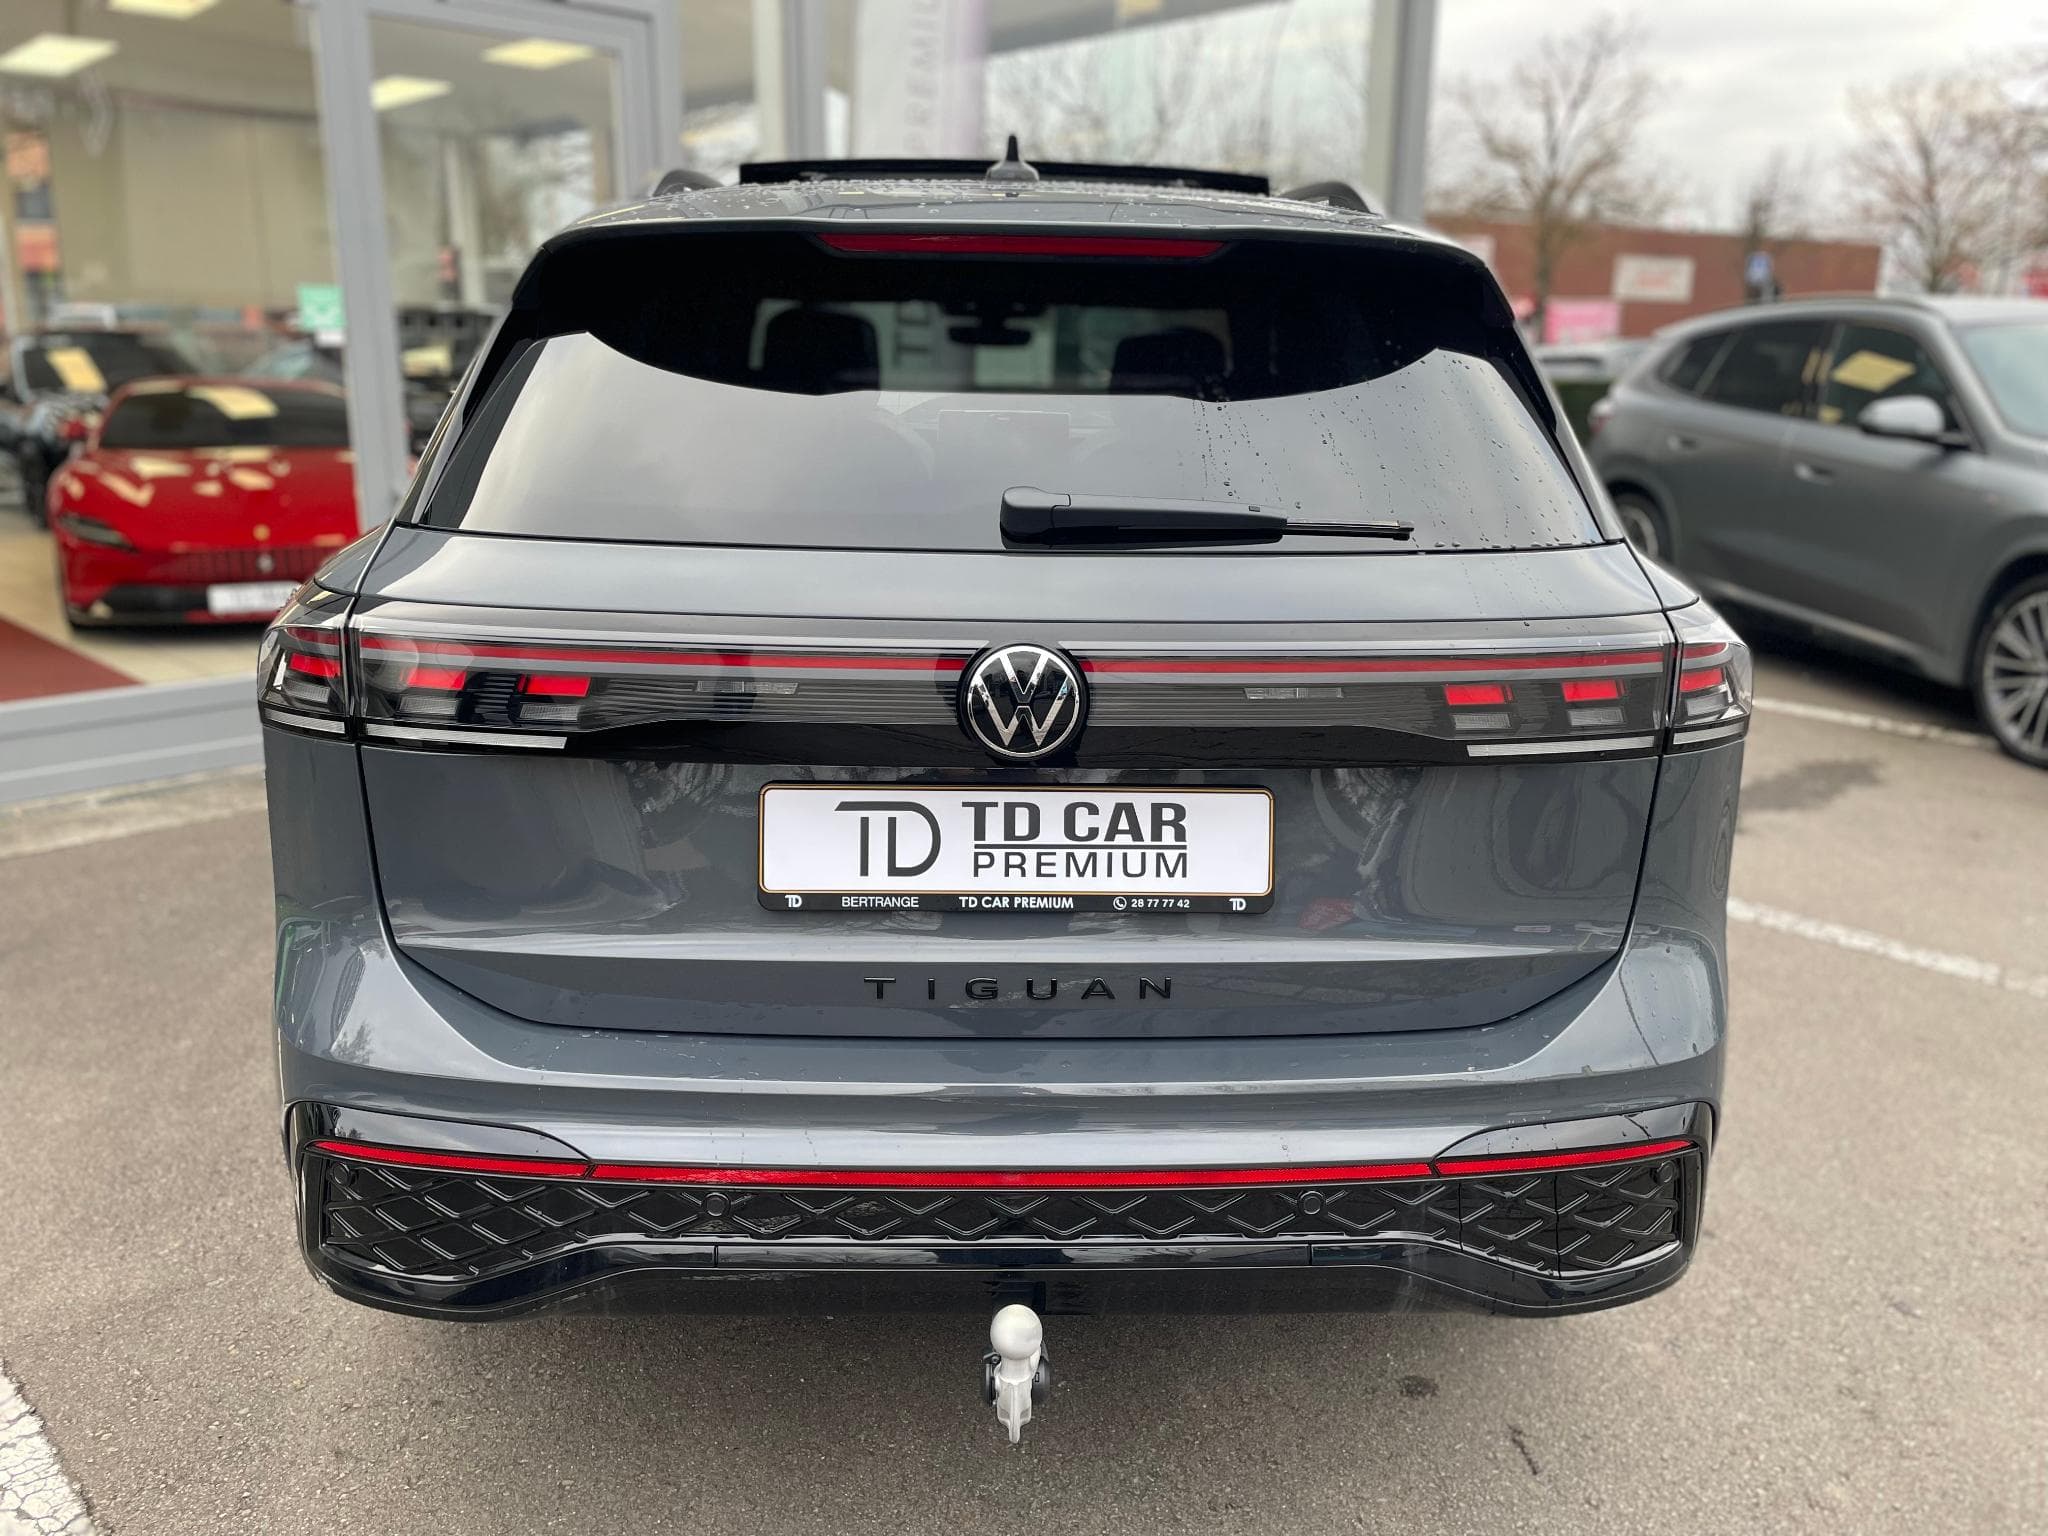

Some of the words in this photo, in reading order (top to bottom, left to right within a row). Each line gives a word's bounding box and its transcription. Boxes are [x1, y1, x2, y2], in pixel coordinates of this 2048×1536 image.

[962, 801, 1040, 841] TD
[1064, 802, 1187, 842] CAR
[835, 800, 941, 877] TD
[973, 852, 1187, 878] PREMIUM
[785, 895, 802, 908] TD
[841, 896, 919, 908] BERTRANGE
[959, 896, 978, 908] TD
[981, 896, 1009, 908] CAR
[1014, 896, 1074, 909] PREMIUM
[1131, 898, 1144, 908] 28
[1147, 898, 1158, 908] 77
[1162, 898, 1174, 908] 77
[1177, 898, 1190, 909] 42
[1229, 898, 1246, 911] TD
[863, 977, 1172, 1000] TIGUAN
